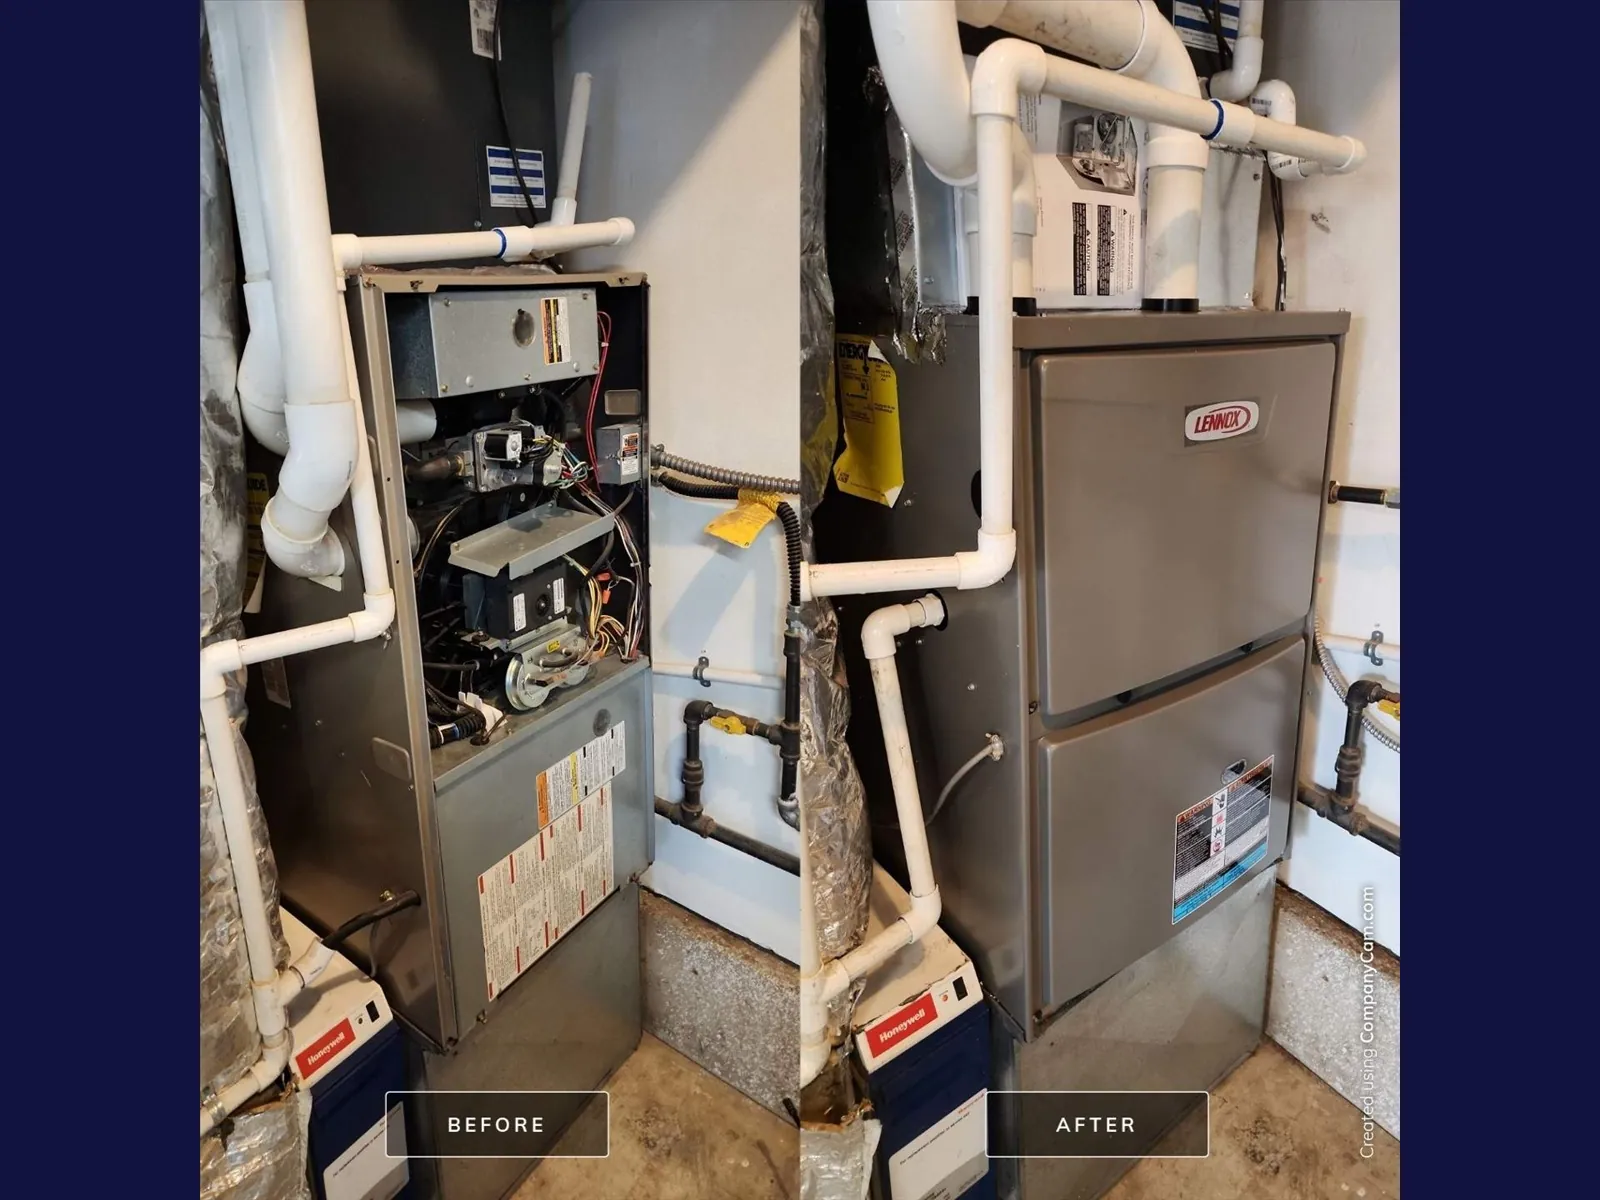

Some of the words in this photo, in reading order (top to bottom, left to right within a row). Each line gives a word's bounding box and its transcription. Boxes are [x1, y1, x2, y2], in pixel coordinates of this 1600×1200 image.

[1194, 410, 1242, 434] LENNOX
[879, 1007, 926, 1043] Honeywell
[307, 1031, 346, 1066] Honeywell
